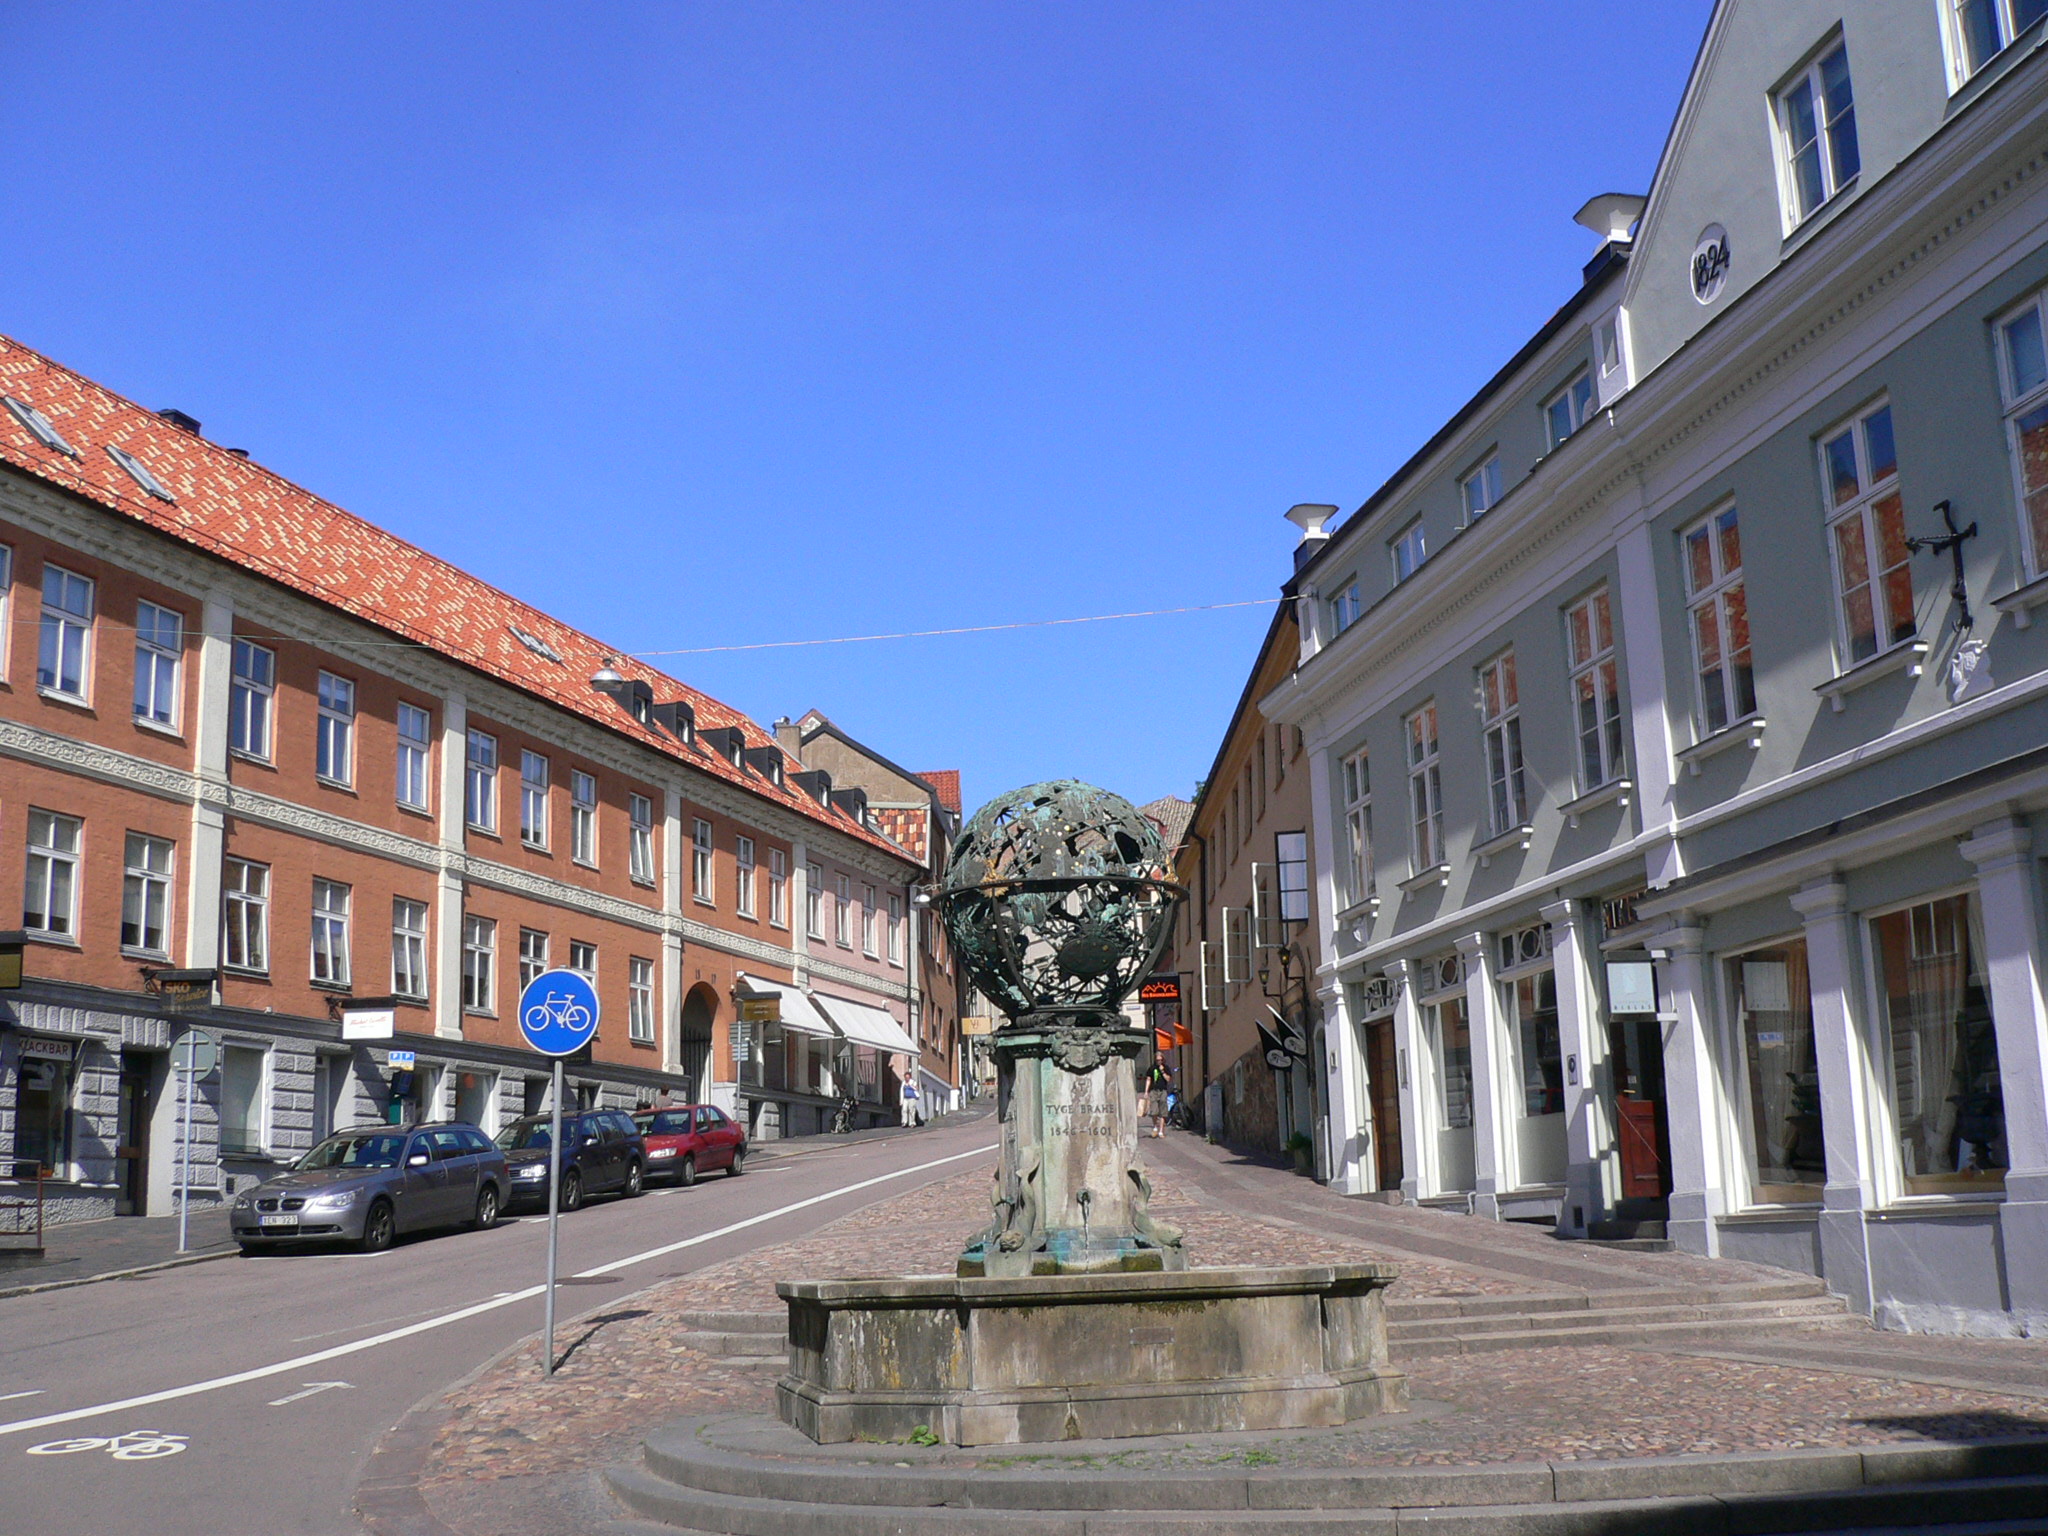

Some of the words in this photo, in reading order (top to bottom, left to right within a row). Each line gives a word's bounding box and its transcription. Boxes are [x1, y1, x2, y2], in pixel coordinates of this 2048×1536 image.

[1693, 235, 1730, 292] 1824
[164, 982, 191, 994] SKO
[1046, 1104, 1074, 1114] TYGE
[1080, 1104, 1115, 1114] BRAHE
